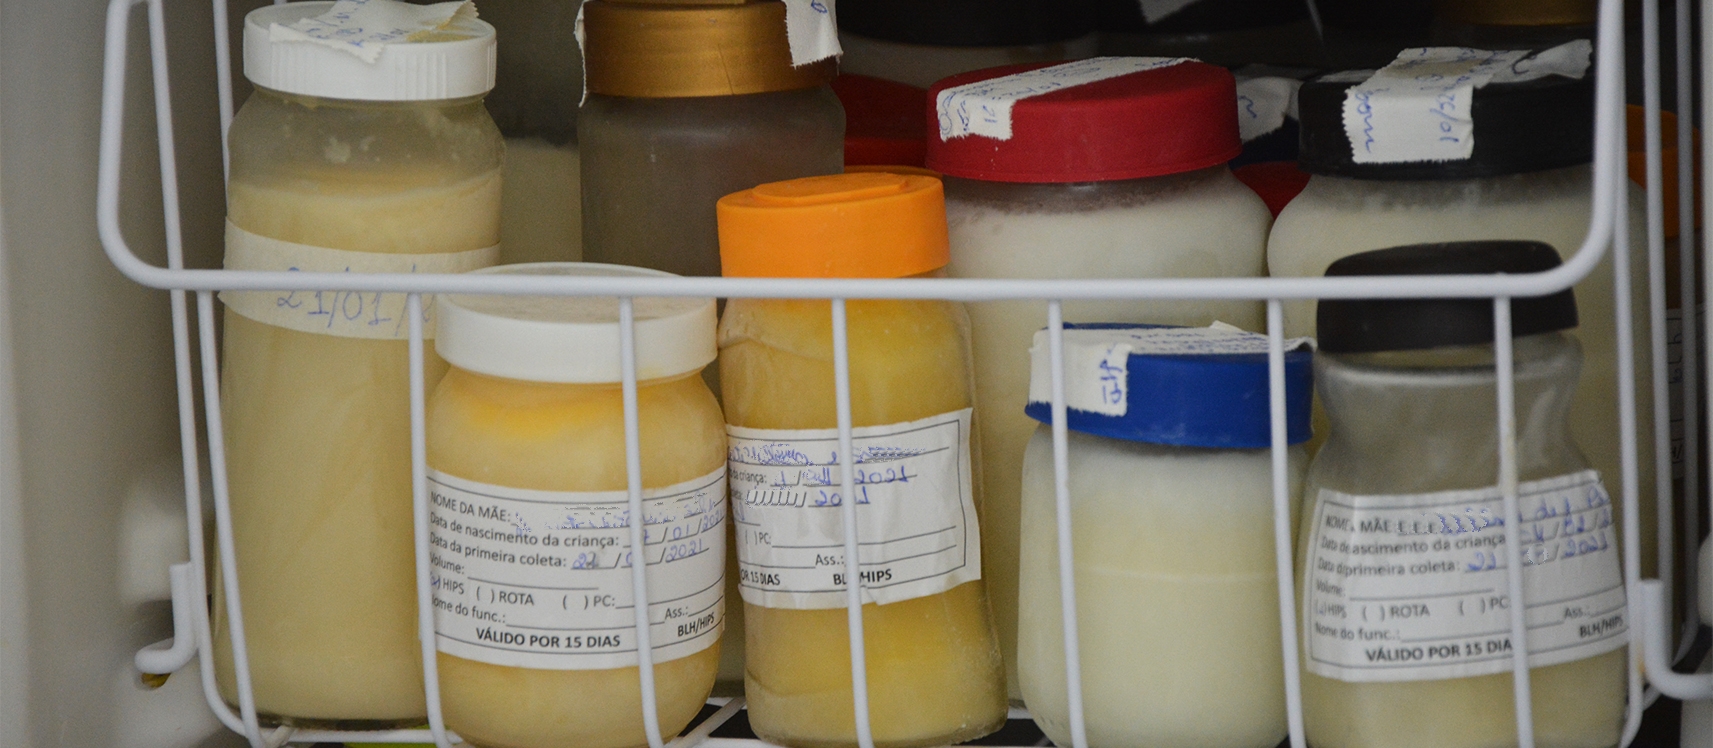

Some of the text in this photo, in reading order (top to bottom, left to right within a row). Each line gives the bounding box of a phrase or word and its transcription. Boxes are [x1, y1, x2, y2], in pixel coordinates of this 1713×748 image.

[430, 491, 457, 512] NOME
[460, 501, 475, 516] DA
[478, 505, 511, 522] MÃE:
[815, 489, 871, 508] 201
[430, 511, 448, 530] Data
[450, 520, 463, 534] de
[465, 526, 538, 546] nascimento
[542, 534, 559, 547] da
[564, 534, 619, 551] criança:
[759, 532, 771, 546] PC:
[430, 532, 567, 568] Data da primeira coleta:
[1352, 538, 1429, 555] ascimento
[1433, 537, 1452, 550] da
[815, 553, 845, 567] Ass.:
[1345, 562, 1406, 578] primeira
[1410, 558, 1461, 574] coleta:
[740, 568, 781, 586] OR 15 DIAS
[443, 579, 465, 596] HIPS
[499, 591, 535, 607] ROTA
[593, 595, 615, 608] PC:
[455, 602, 469, 617] do
[472, 605, 506, 624] func.:
[664, 605, 689, 621] Ass.:
[1390, 604, 1430, 618] ROTA
[677, 611, 715, 638] BLH/HIPS
[1315, 622, 1337, 638] Nome
[1340, 628, 1355, 641] do
[476, 626, 621, 648] VÁLIDO POR 15 DIAS
[1366, 638, 1513, 662] VÁLIDO POR 15 DIA
